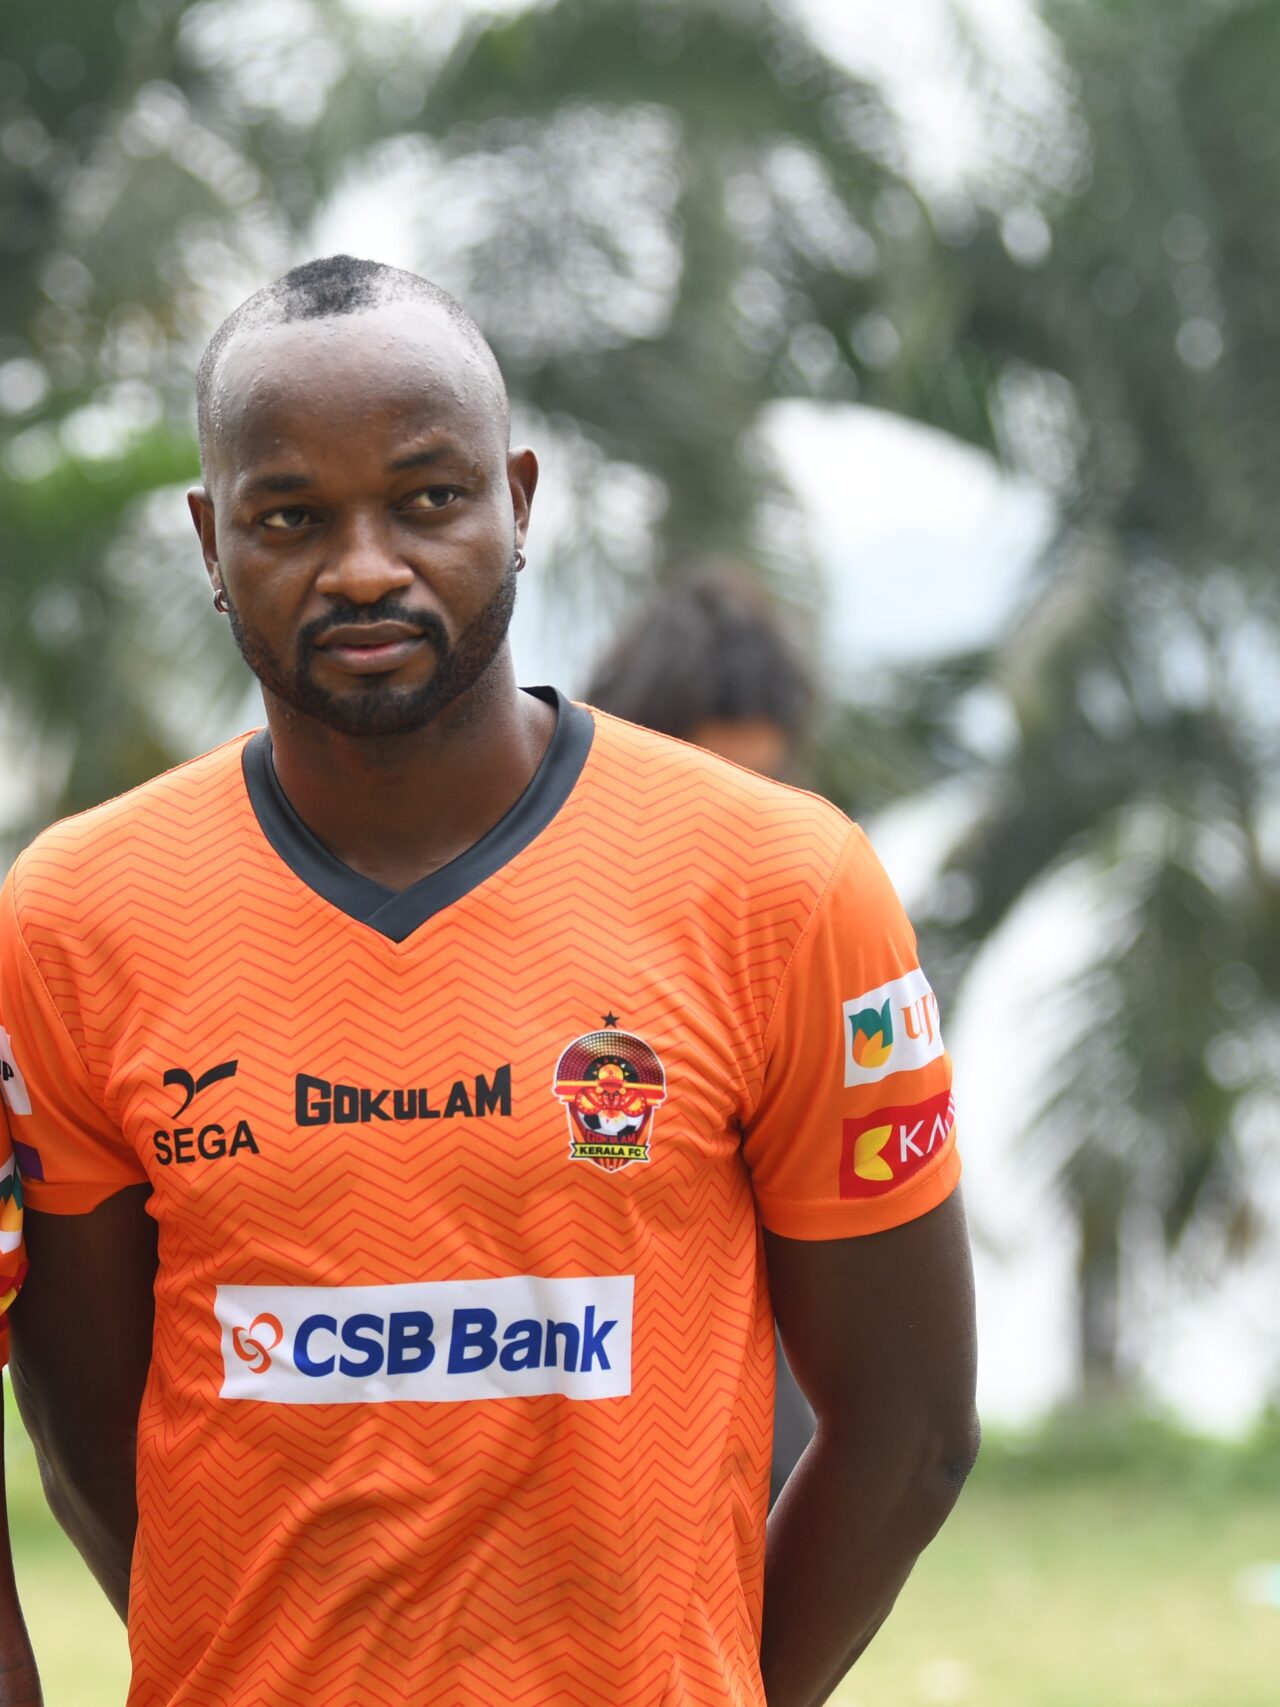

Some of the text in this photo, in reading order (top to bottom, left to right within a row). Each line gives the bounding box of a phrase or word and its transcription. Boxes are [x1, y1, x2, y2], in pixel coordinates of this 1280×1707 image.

[295, 1064, 511, 1127] GOKULAM
[153, 1120, 260, 1166] SEGA
[580, 1146, 641, 1157] KERALA FC
[293, 1305, 618, 1378] CSB Bank
